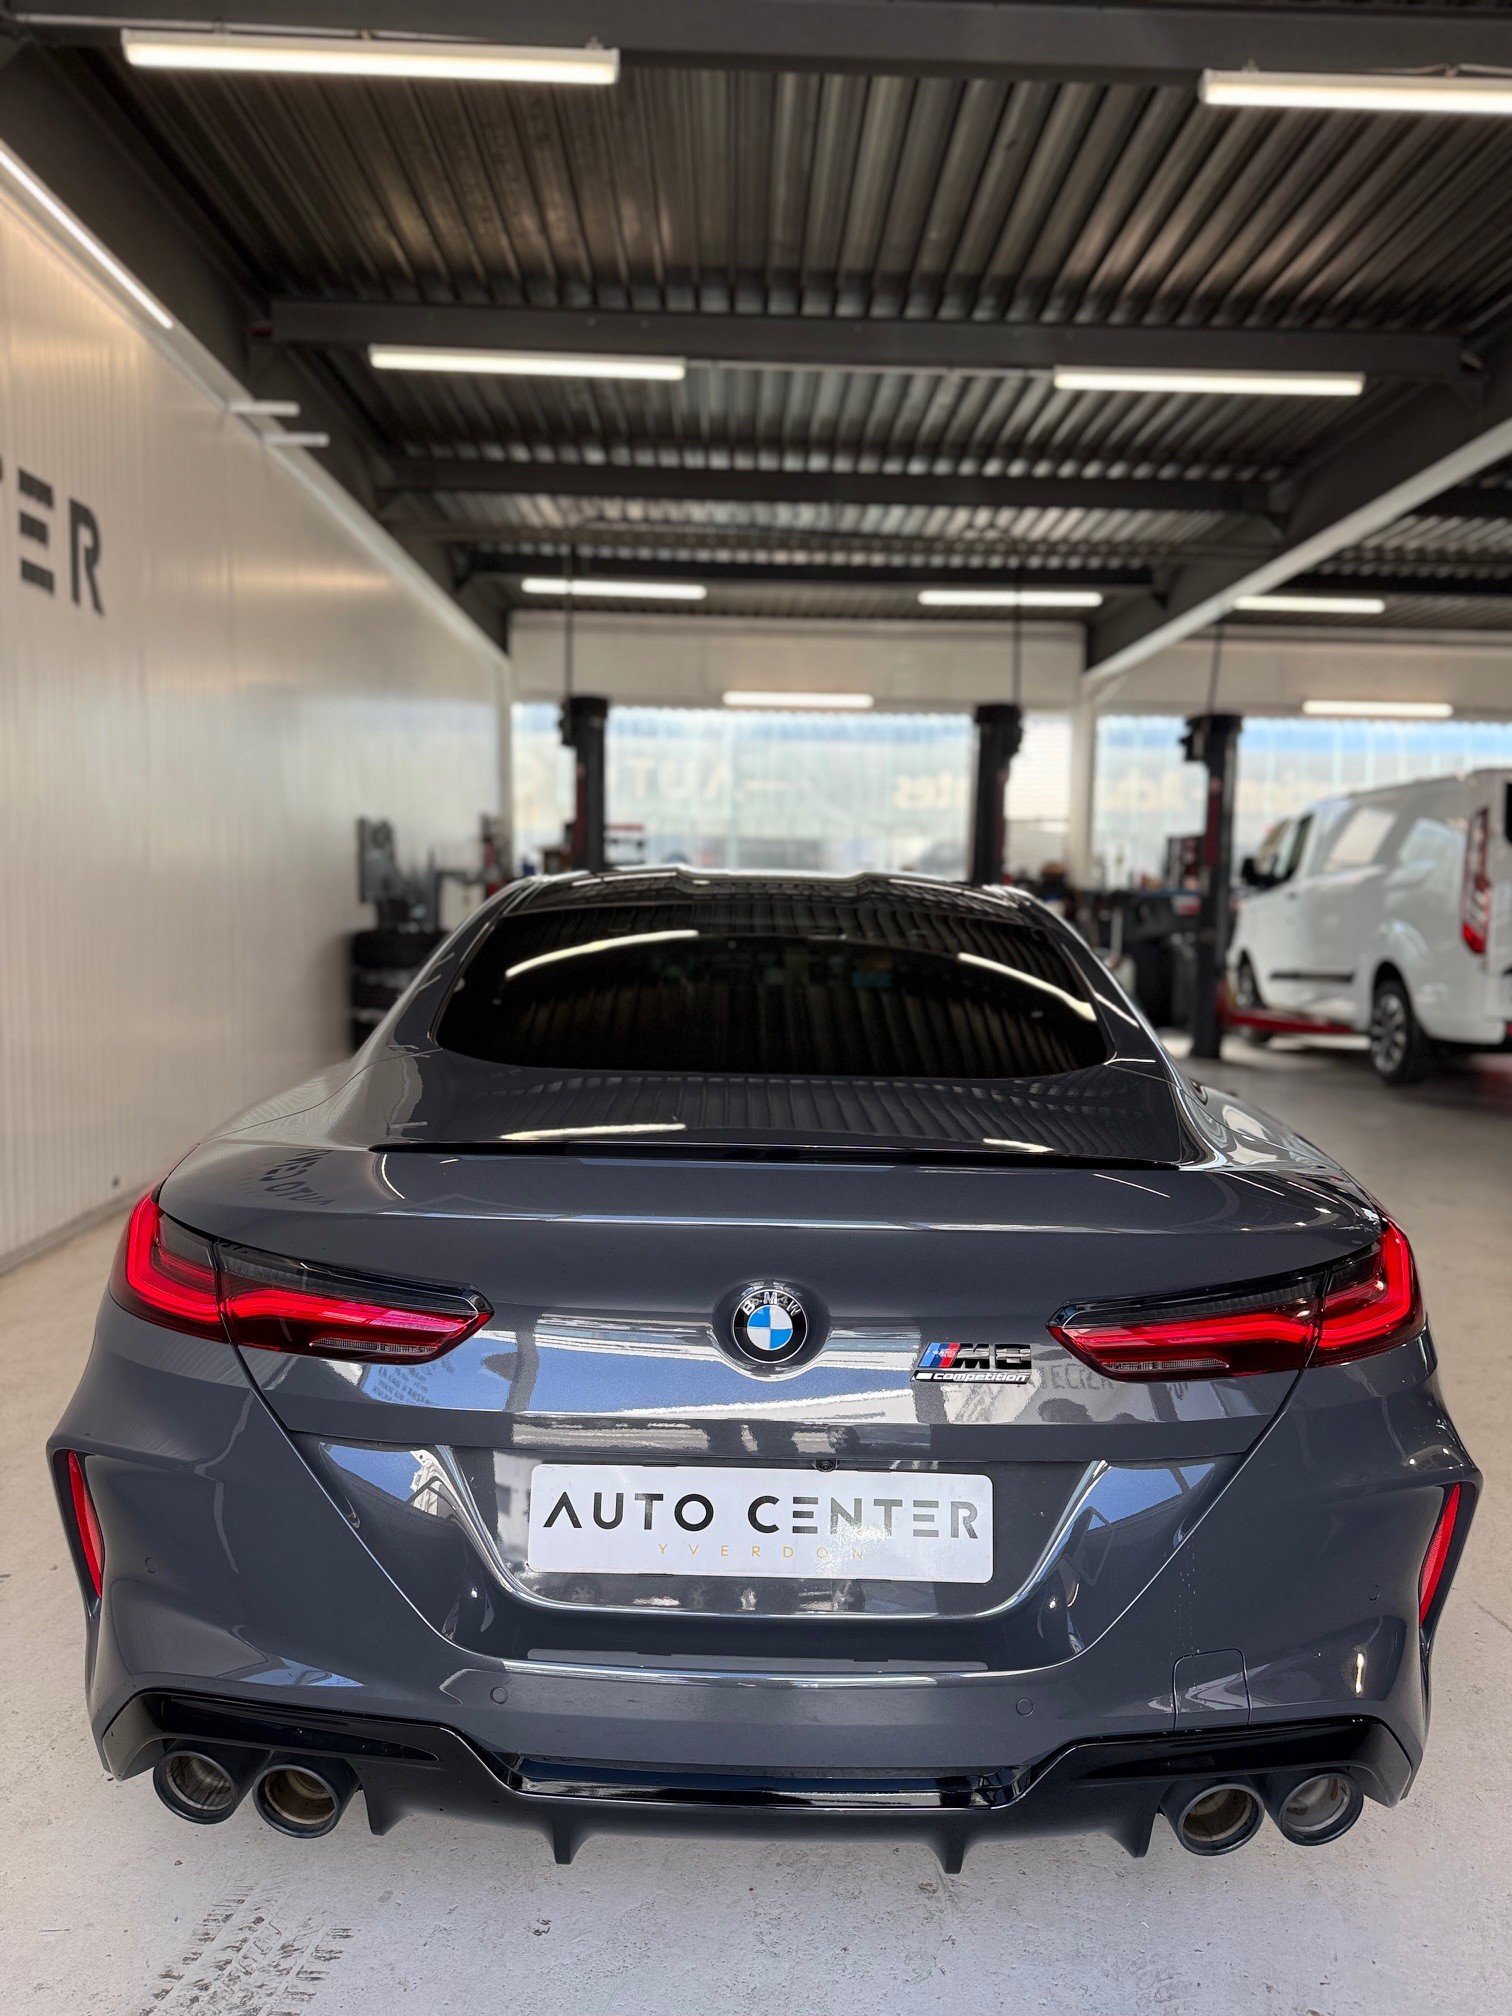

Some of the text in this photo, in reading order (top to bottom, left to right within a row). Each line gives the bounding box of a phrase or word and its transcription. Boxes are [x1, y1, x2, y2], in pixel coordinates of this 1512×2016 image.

[0, 456, 104, 617] ER
[742, 1291, 801, 1316] BMW
[933, 1372, 1031, 1383] competition
[542, 1491, 979, 1539] AUTO CENTER
[658, 1543, 864, 1560] YVERDON
